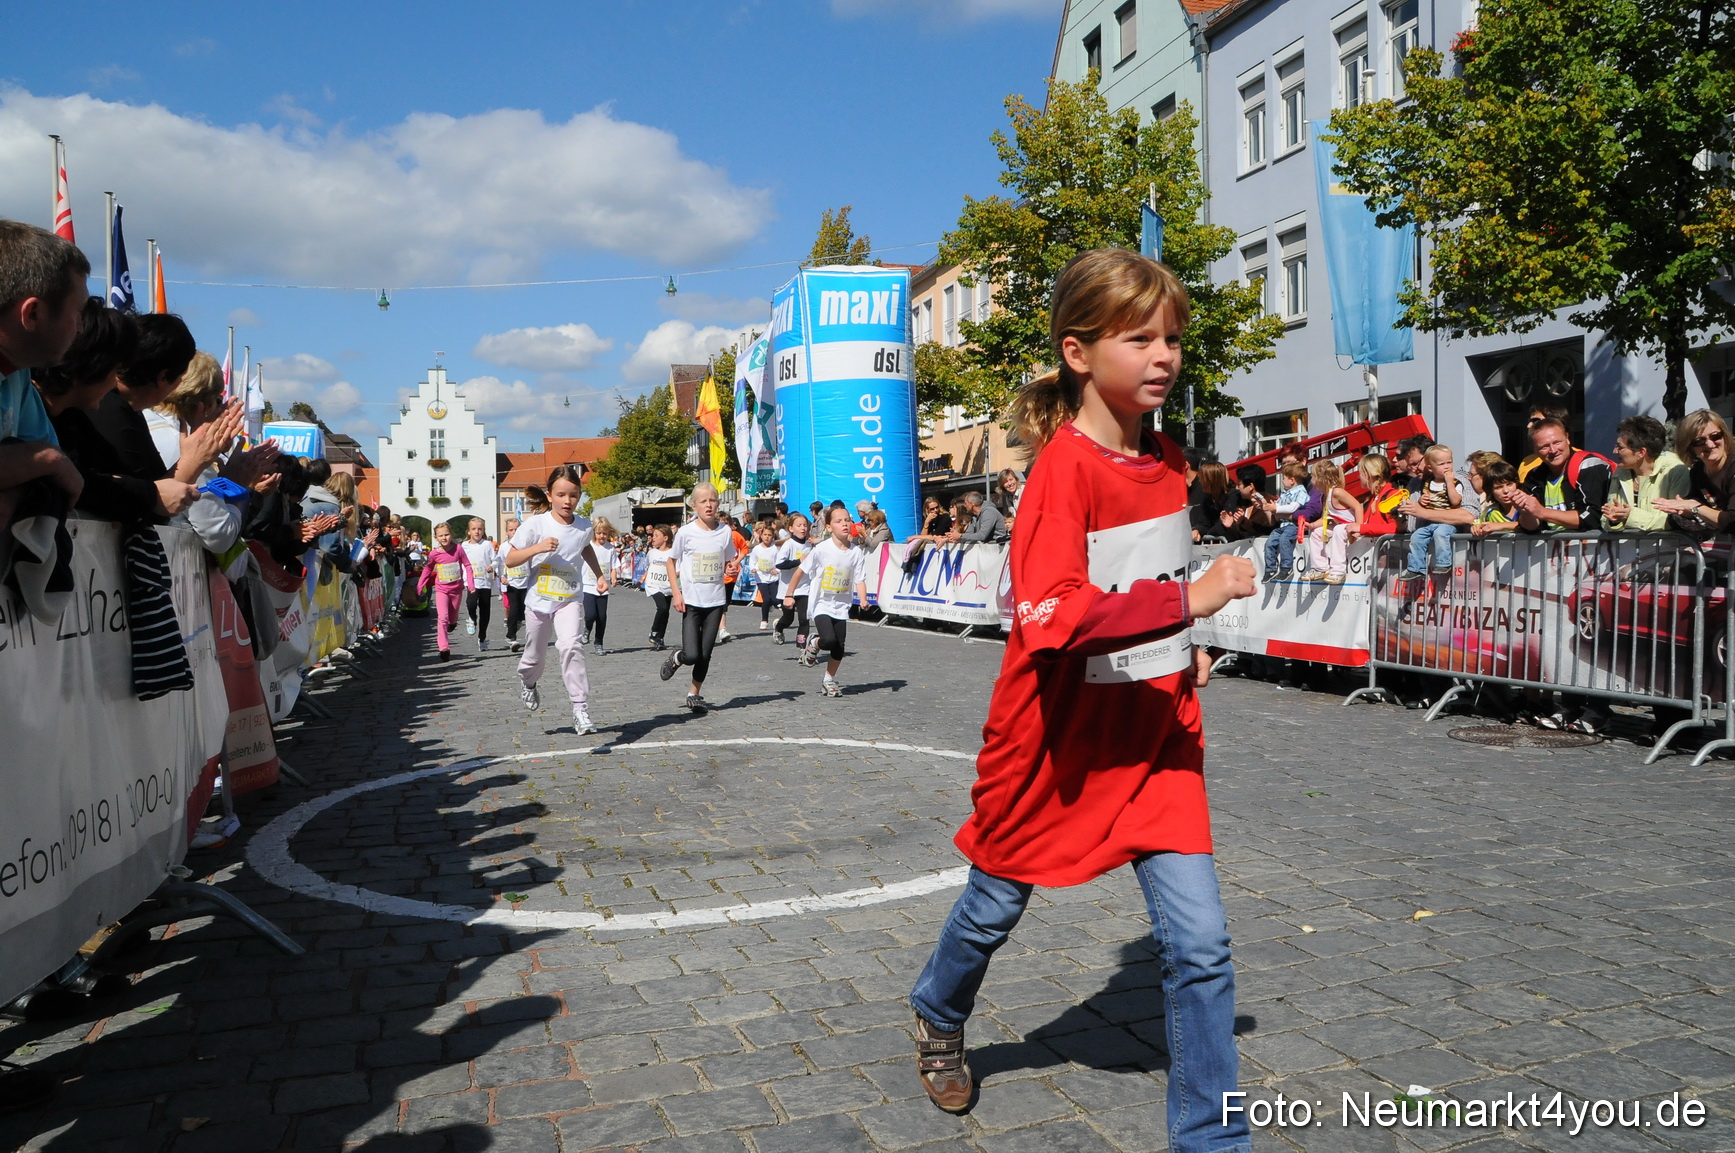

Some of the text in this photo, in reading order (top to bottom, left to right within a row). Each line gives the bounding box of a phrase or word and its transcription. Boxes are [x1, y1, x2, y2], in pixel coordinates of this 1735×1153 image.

[819, 283, 901, 326] maxi
[779, 353, 797, 381] dsl
[874, 348, 901, 375] dsl
[269, 432, 312, 453] maxi
[702, 561, 724, 572] 7184
[551, 579, 578, 591] 7036
[1443, 589, 1457, 601] DER
[1402, 602, 1543, 635] SEAT IBIZA ST.
[1130, 645, 1172, 662] PFLEIDERER
